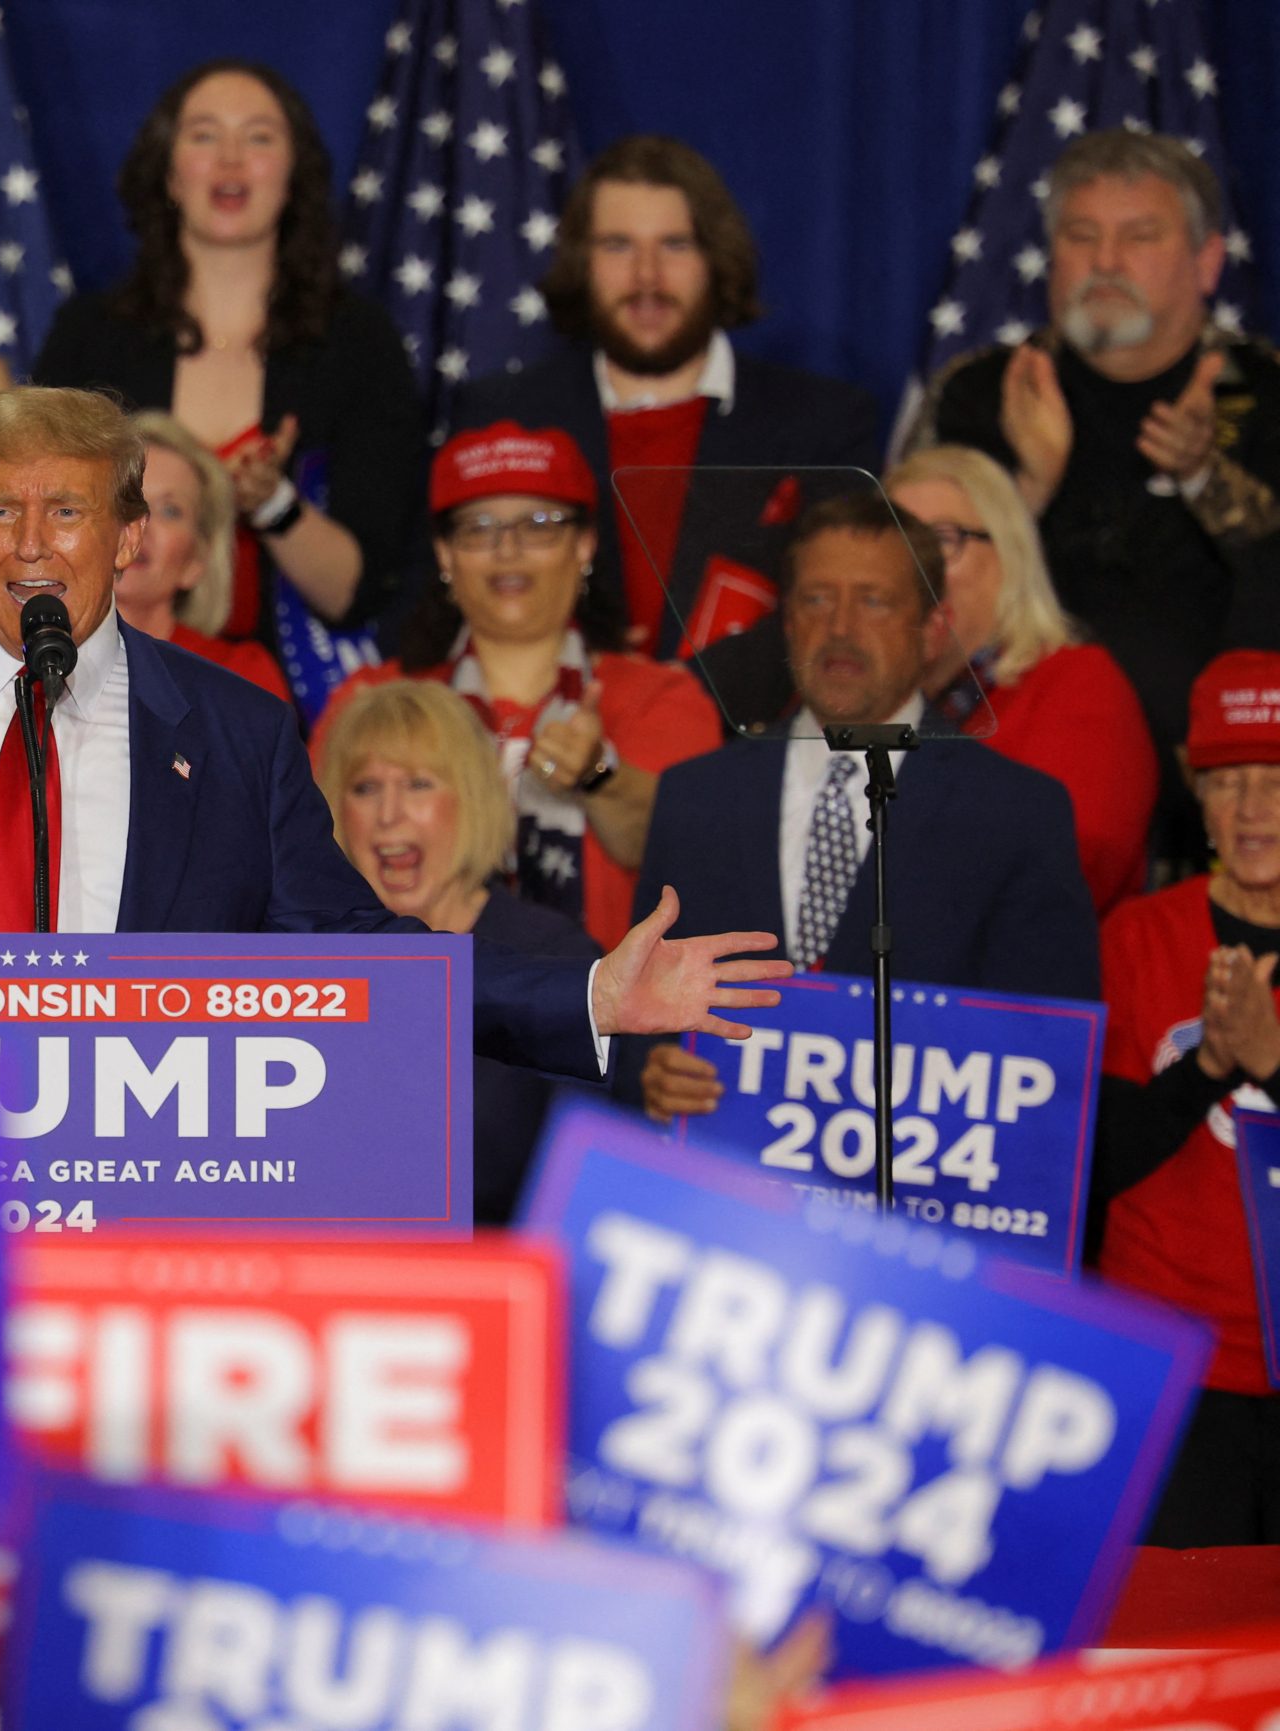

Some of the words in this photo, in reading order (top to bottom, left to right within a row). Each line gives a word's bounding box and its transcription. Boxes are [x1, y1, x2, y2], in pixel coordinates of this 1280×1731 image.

[130, 983, 192, 1018] TO
[205, 983, 347, 1018] 88022
[724, 1024, 1058, 1124] TRUMP
[49, 1160, 162, 1183] GREAT
[173, 1160, 297, 1183] AGAIN!
[759, 1101, 1000, 1193] 2024
[792, 1182, 898, 1216] TRUM
[904, 1195, 946, 1225] TO
[950, 1201, 1049, 1238] 88022
[588, 1212, 1116, 1490] TRUMP
[597, 1353, 1000, 1590] 2024
[62, 1557, 654, 1731] TRUMP
